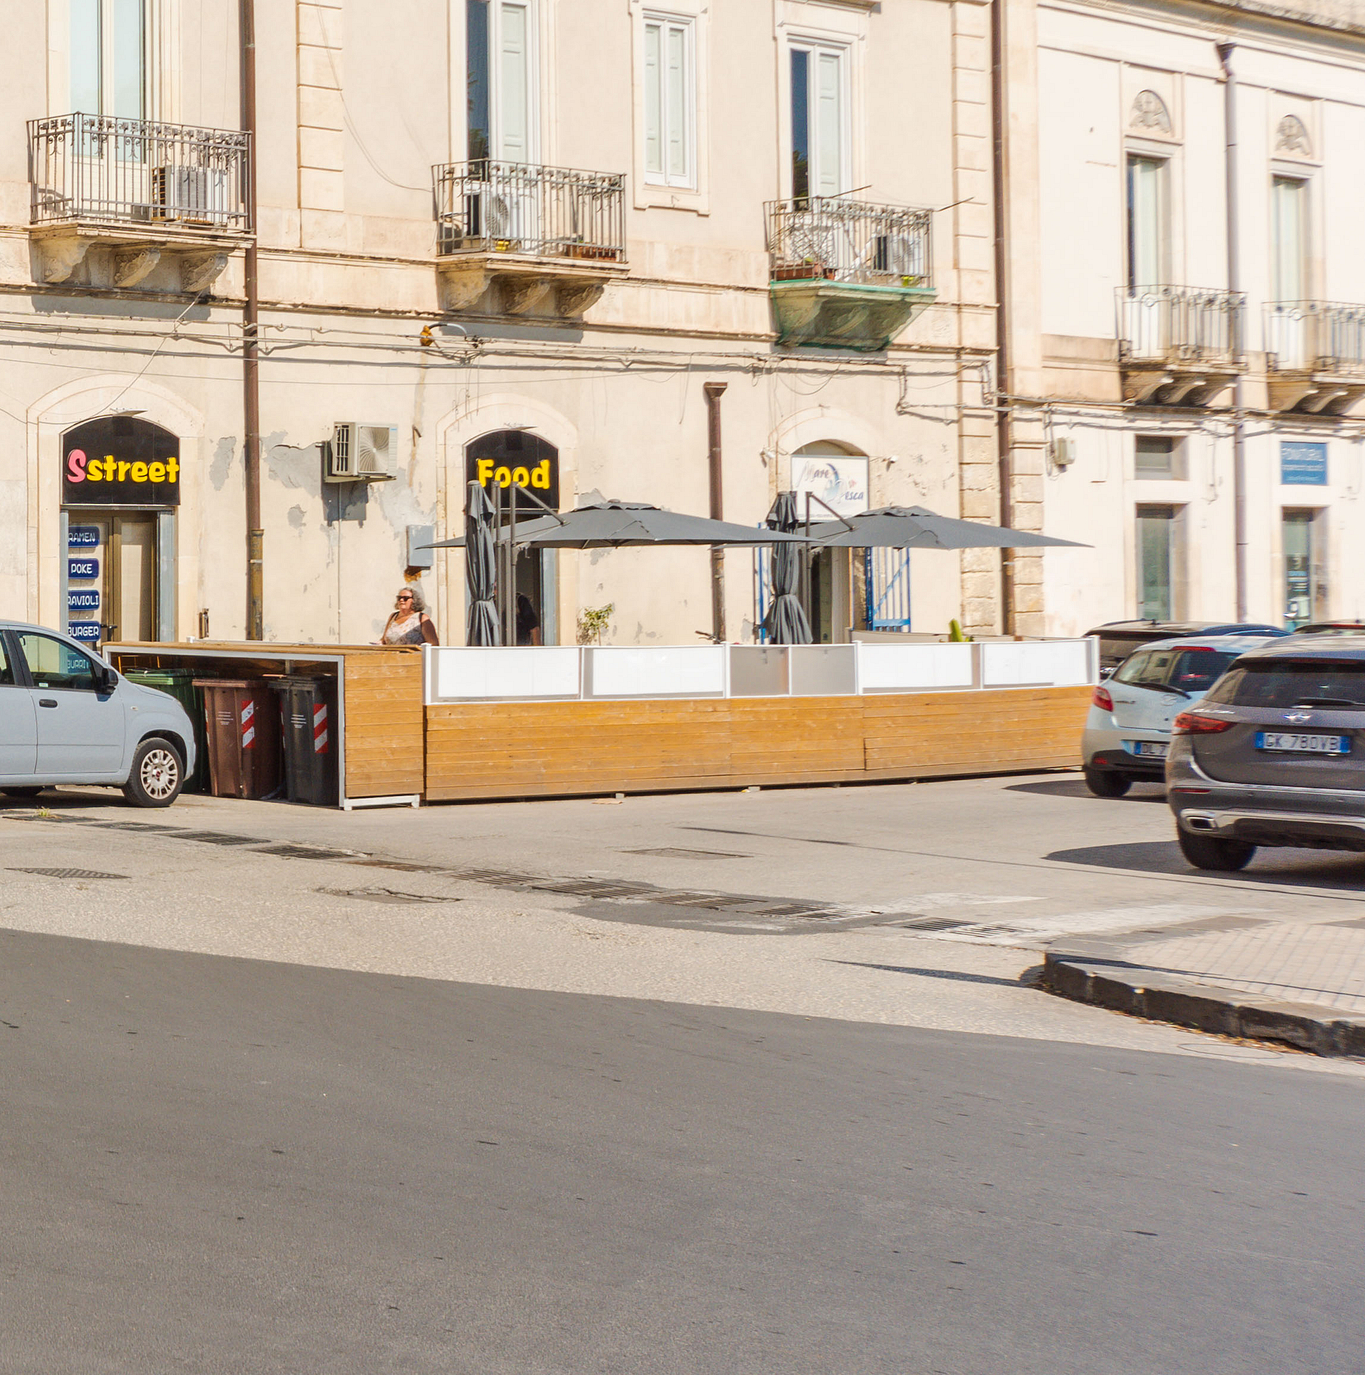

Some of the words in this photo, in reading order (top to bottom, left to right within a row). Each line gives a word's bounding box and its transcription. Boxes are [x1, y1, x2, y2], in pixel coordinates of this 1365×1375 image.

[475, 457, 551, 490] Food
[68, 532, 96, 543] RAMEN
[70, 563, 93, 574] POKE
[67, 595, 99, 606] RAVIOLI
[68, 626, 100, 637] BURGER
[1266, 734, 1283, 748] GK
[1141, 743, 1153, 755] DL
